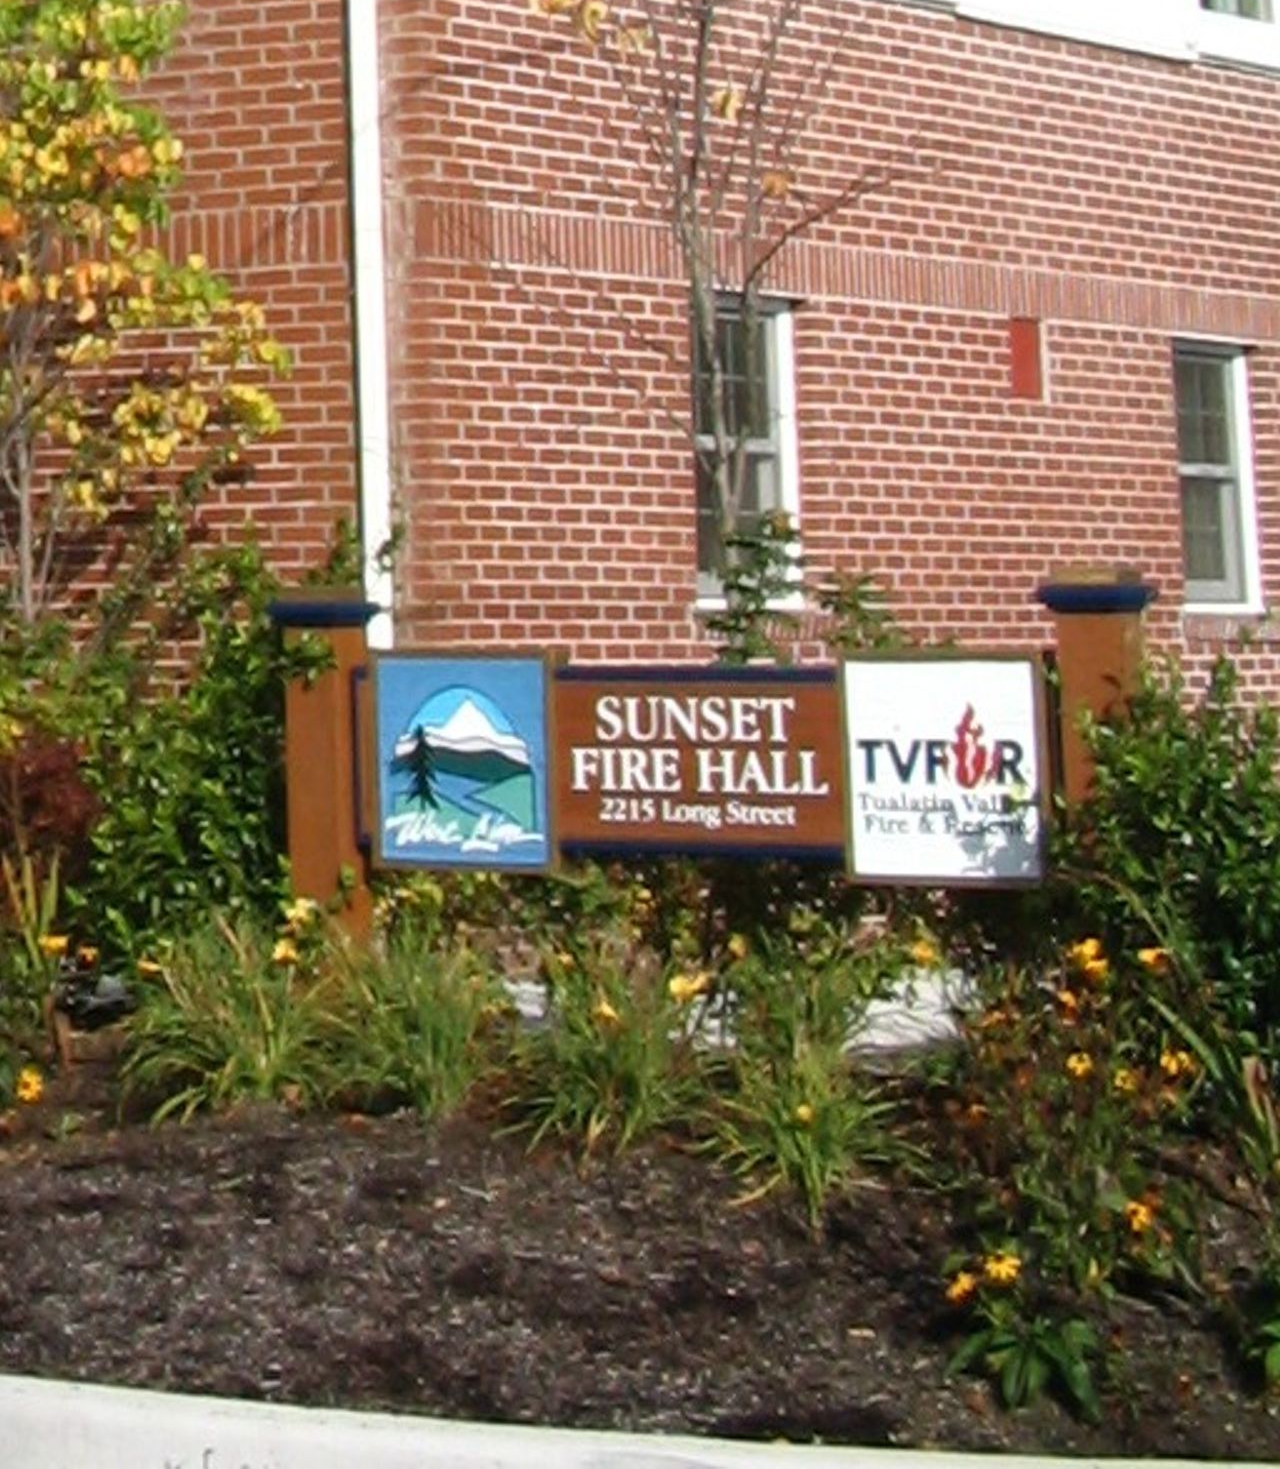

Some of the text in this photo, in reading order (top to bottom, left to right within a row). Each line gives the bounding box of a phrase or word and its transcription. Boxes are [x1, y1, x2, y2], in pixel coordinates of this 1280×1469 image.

[595, 694, 796, 743] SUNSET
[571, 747, 829, 795] FIRE HALL
[599, 798, 796, 828] 2215 Long Street
[864, 814, 909, 834] Fire
